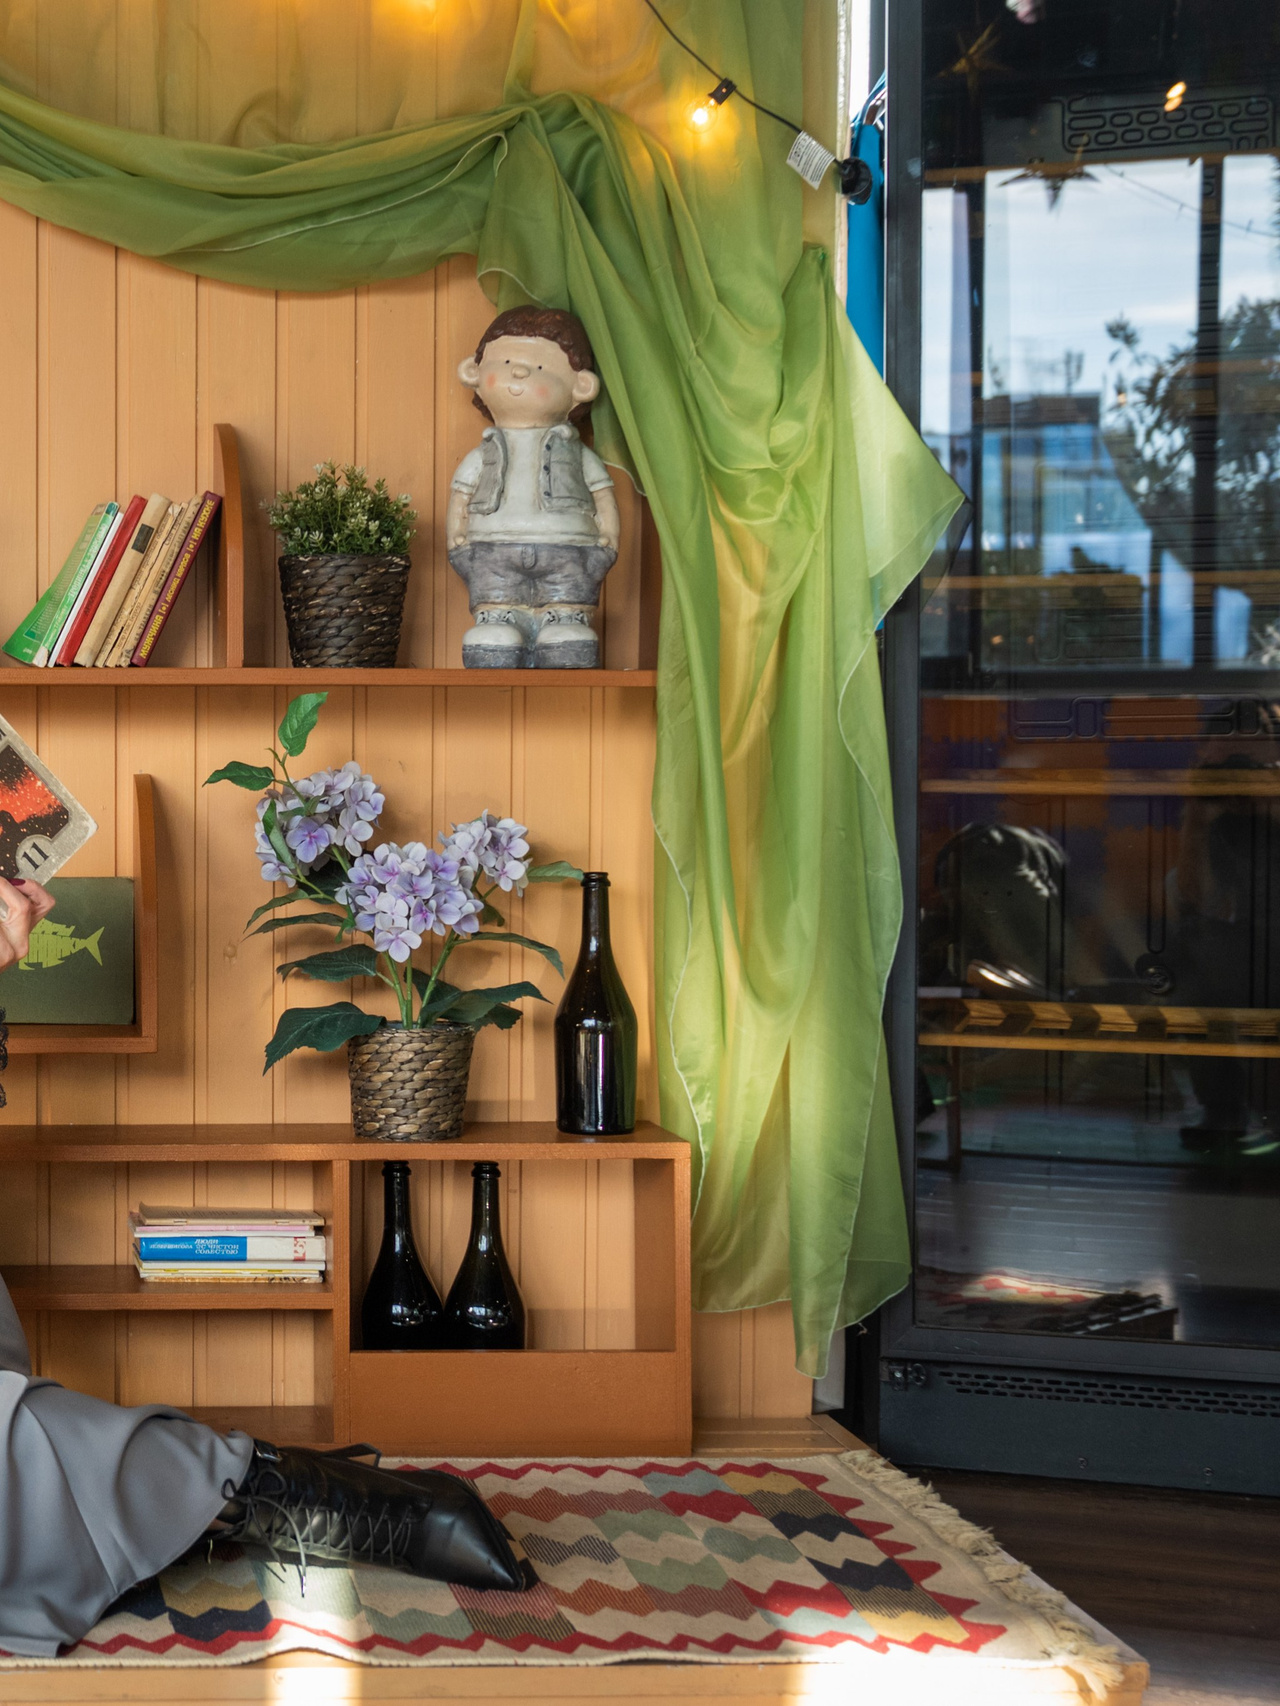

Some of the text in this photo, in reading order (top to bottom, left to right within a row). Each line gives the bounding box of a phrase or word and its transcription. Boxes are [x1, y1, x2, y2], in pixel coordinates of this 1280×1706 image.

[137, 498, 215, 659] МУЖЧИНА ЛЕОНИД КАРПОВ НА КУХНЕ
[21, 842, 50, 873] 11
